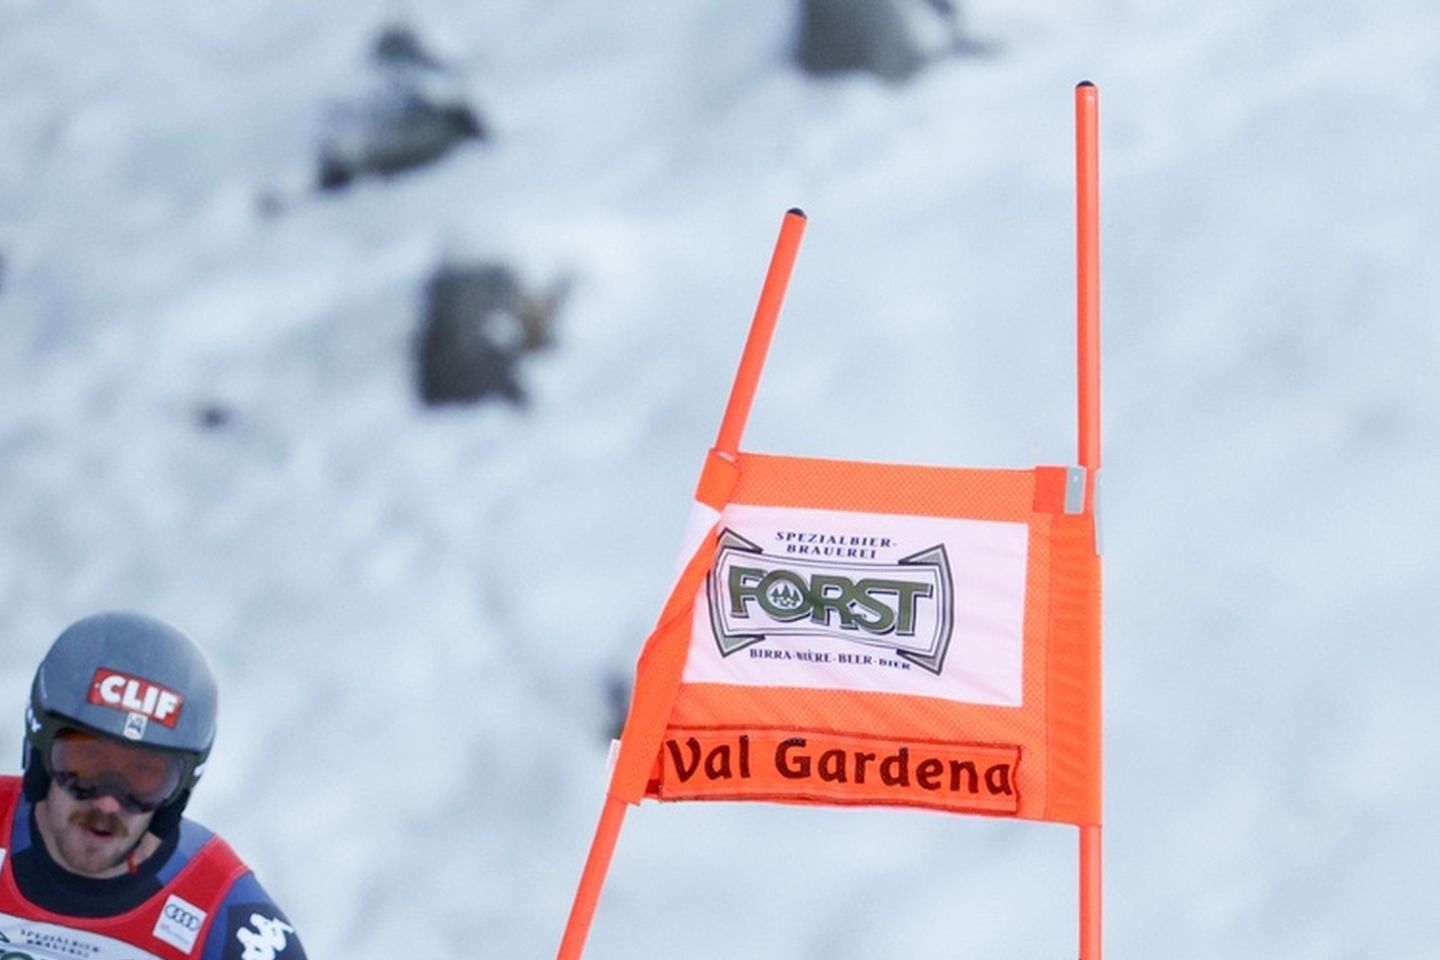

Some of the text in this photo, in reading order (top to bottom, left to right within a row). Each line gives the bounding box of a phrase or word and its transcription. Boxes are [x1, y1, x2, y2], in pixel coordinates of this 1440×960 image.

[776, 531, 897, 548] SPEZIALBIER-
[786, 544, 876, 560] BRAUEREI
[729, 564, 934, 636] FORST
[100, 674, 179, 720] CLIF
[666, 735, 1014, 796] Val Gardena
